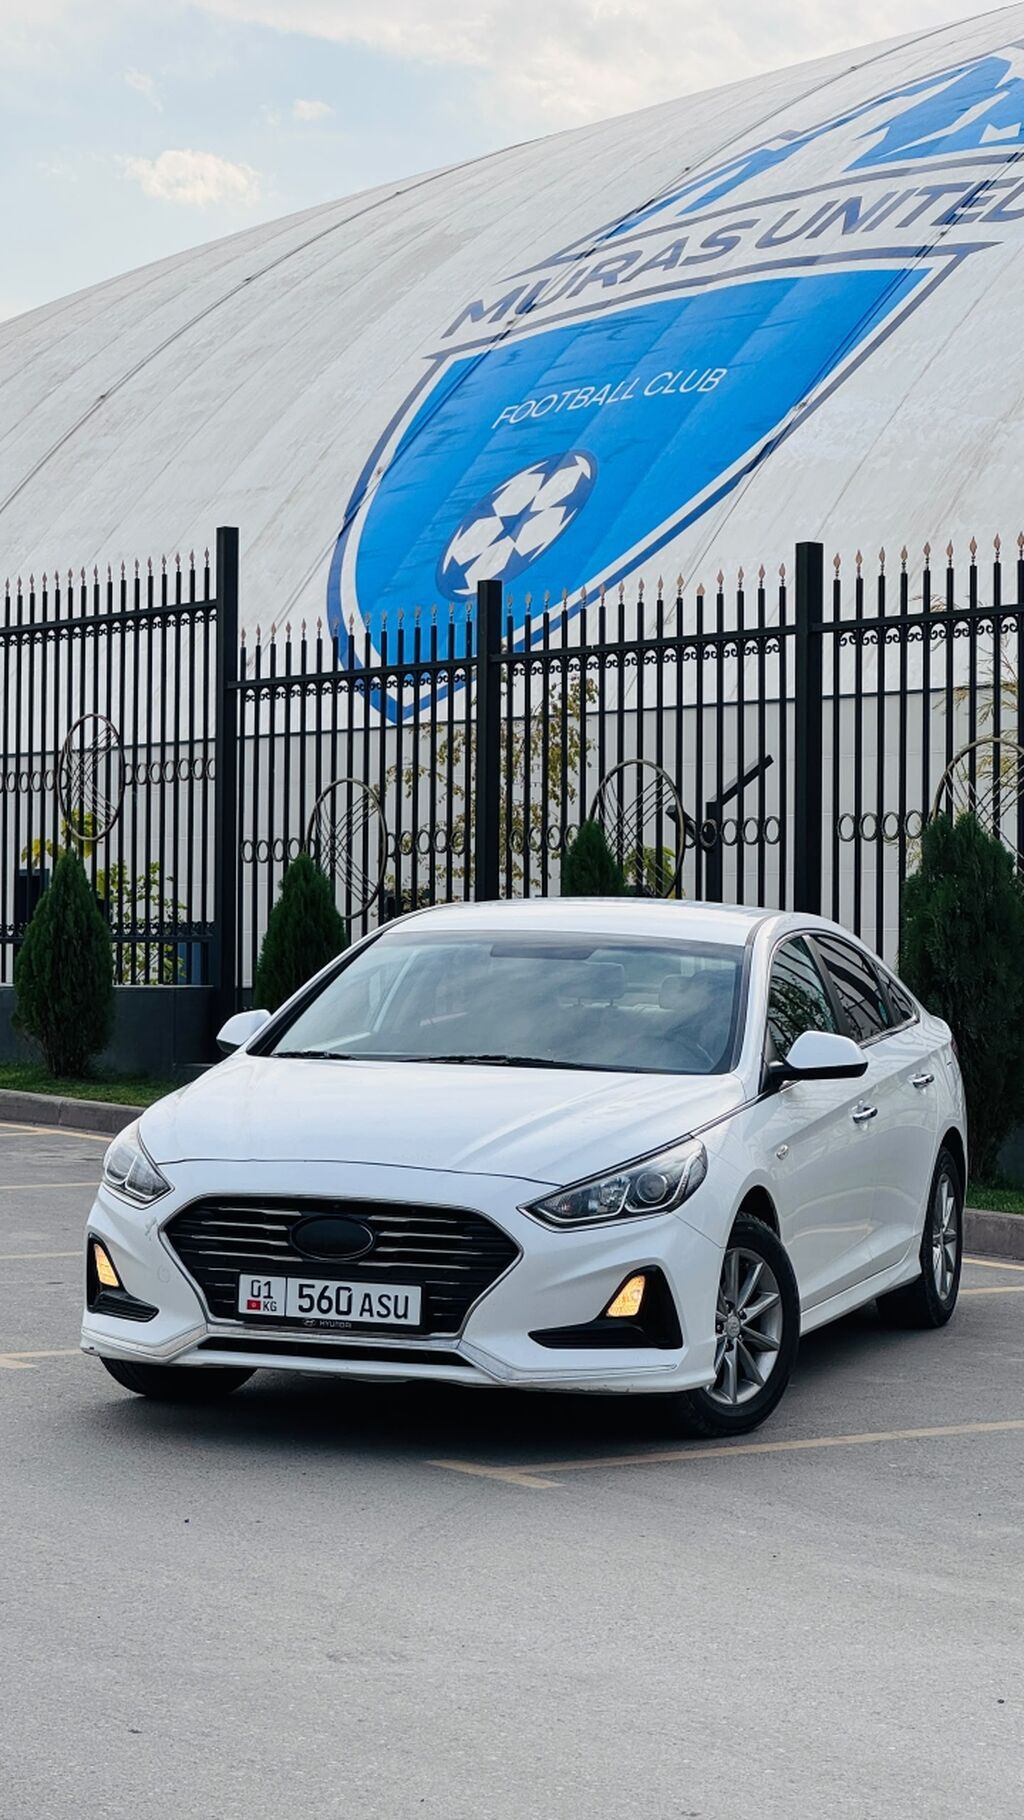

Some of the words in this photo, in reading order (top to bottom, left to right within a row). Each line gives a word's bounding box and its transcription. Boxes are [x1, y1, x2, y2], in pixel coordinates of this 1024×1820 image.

[440, 218, 761, 339] MURAS
[491, 377, 640, 429] FOOTBALL
[643, 368, 727, 396] CLUB
[250, 1279, 274, 1300] 01
[297, 1283, 353, 1316] 560
[359, 1292, 409, 1320] ASU
[262, 1300, 277, 1312] KG
